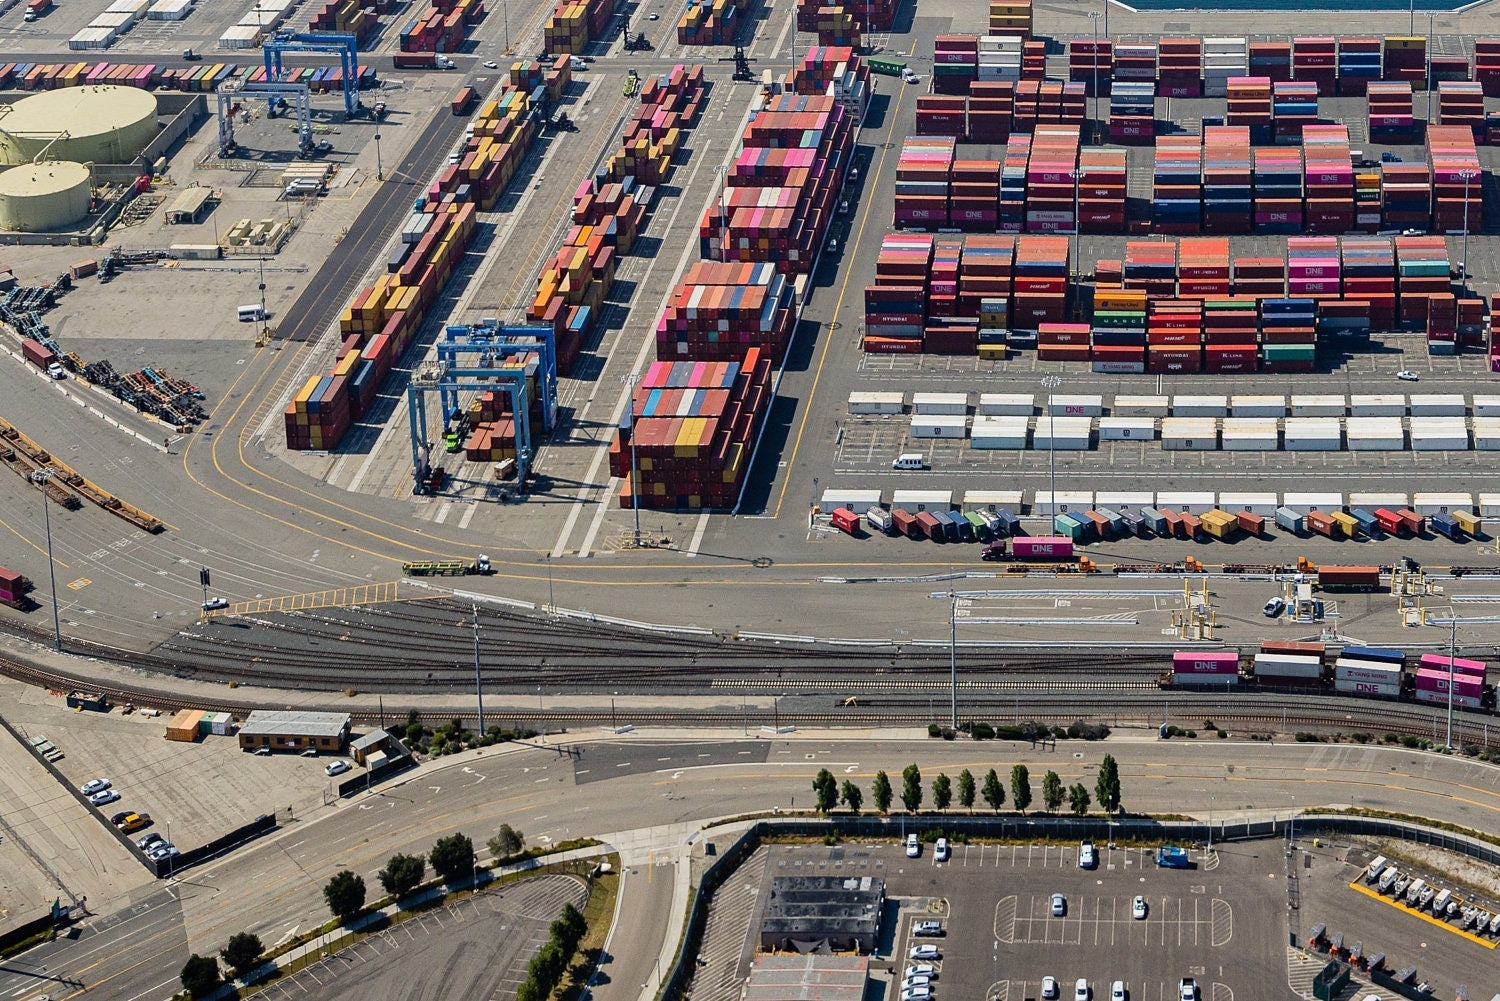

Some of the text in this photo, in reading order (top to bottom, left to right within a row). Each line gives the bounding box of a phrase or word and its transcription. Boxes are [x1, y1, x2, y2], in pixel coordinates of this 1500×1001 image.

[1065, 406, 1084, 414] ONE
[1031, 544, 1053, 553] ONE
[1194, 661, 1217, 670] ONE
[1356, 684, 1379, 693] ONE
[1436, 680, 1460, 691] ONE
